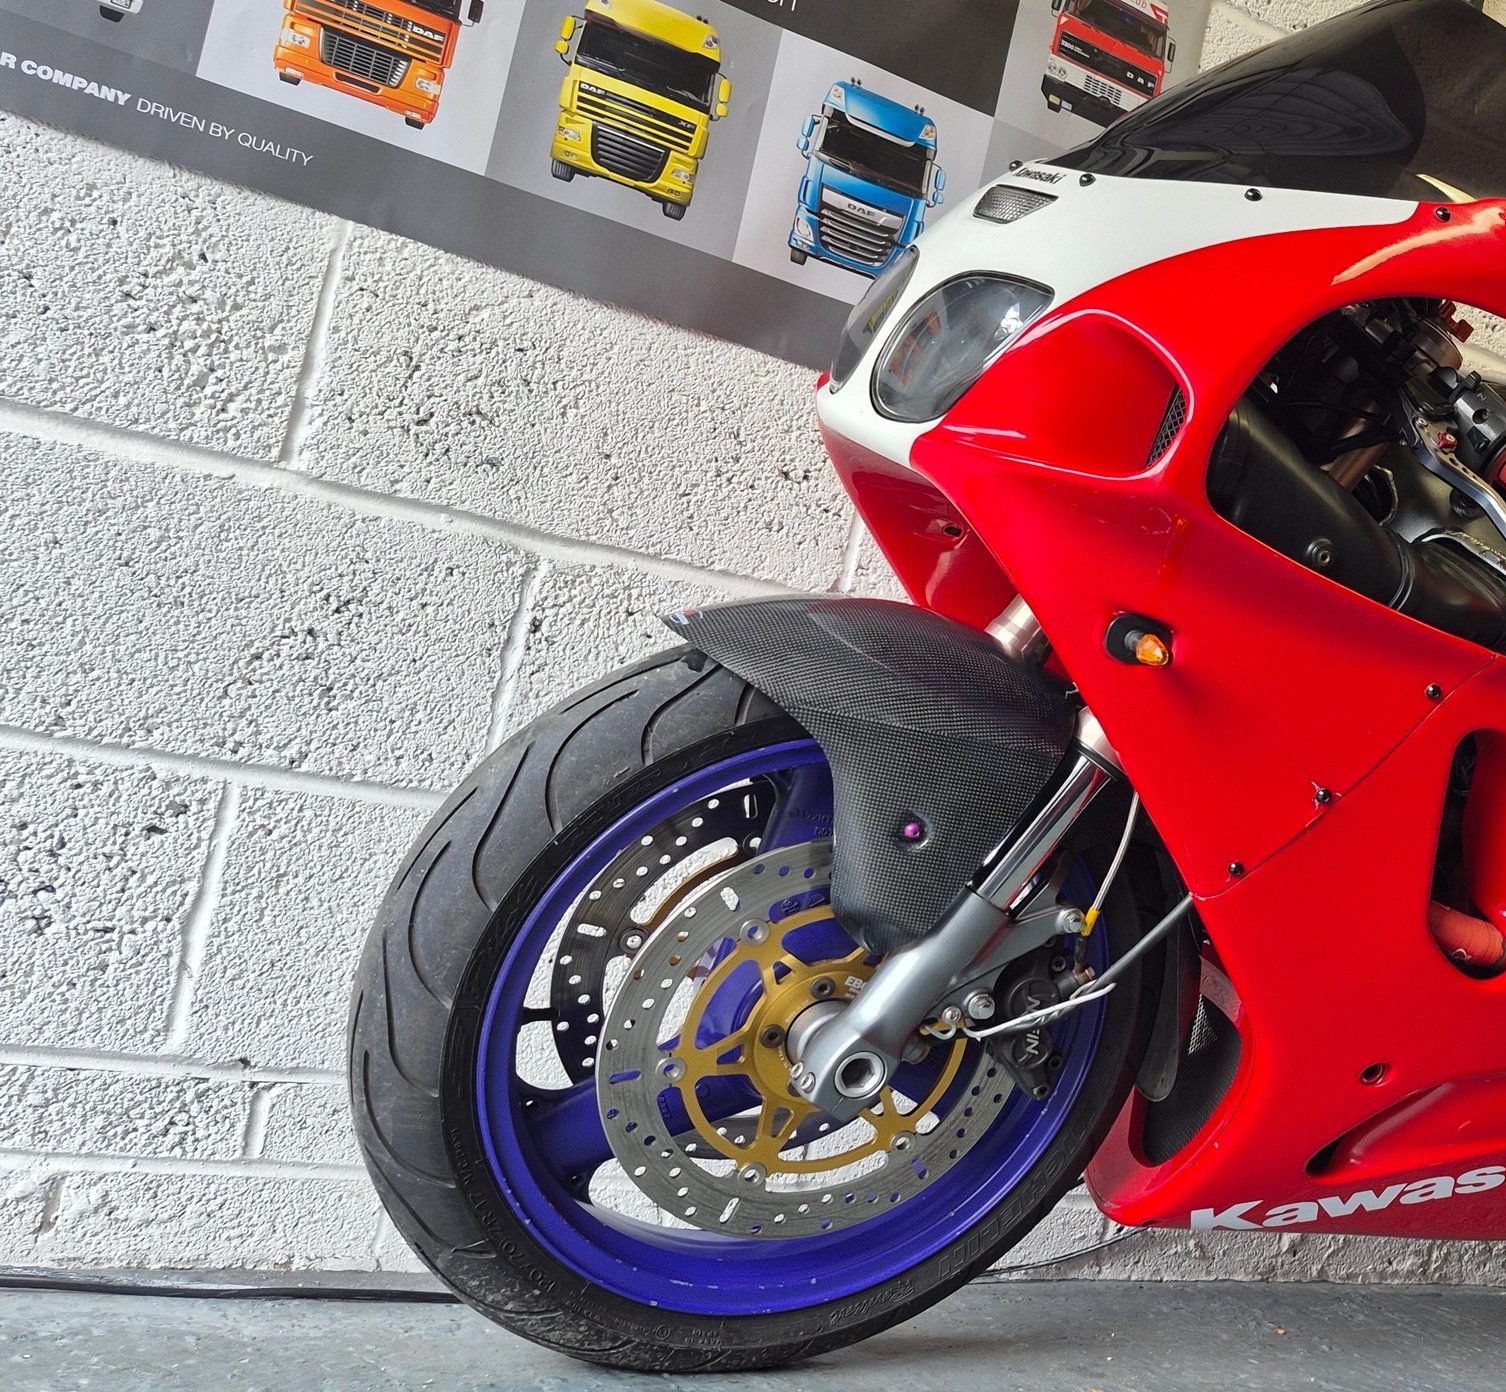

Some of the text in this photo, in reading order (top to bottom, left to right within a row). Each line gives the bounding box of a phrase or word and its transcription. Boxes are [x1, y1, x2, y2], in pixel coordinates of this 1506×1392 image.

[580, 82, 606, 96] DAF
[20, 59, 132, 106] COMPANY
[137, 98, 206, 132] DRIVEN
[209, 121, 236, 141] BY
[237, 132, 314, 166] QUALITY
[847, 202, 876, 217] DAF
